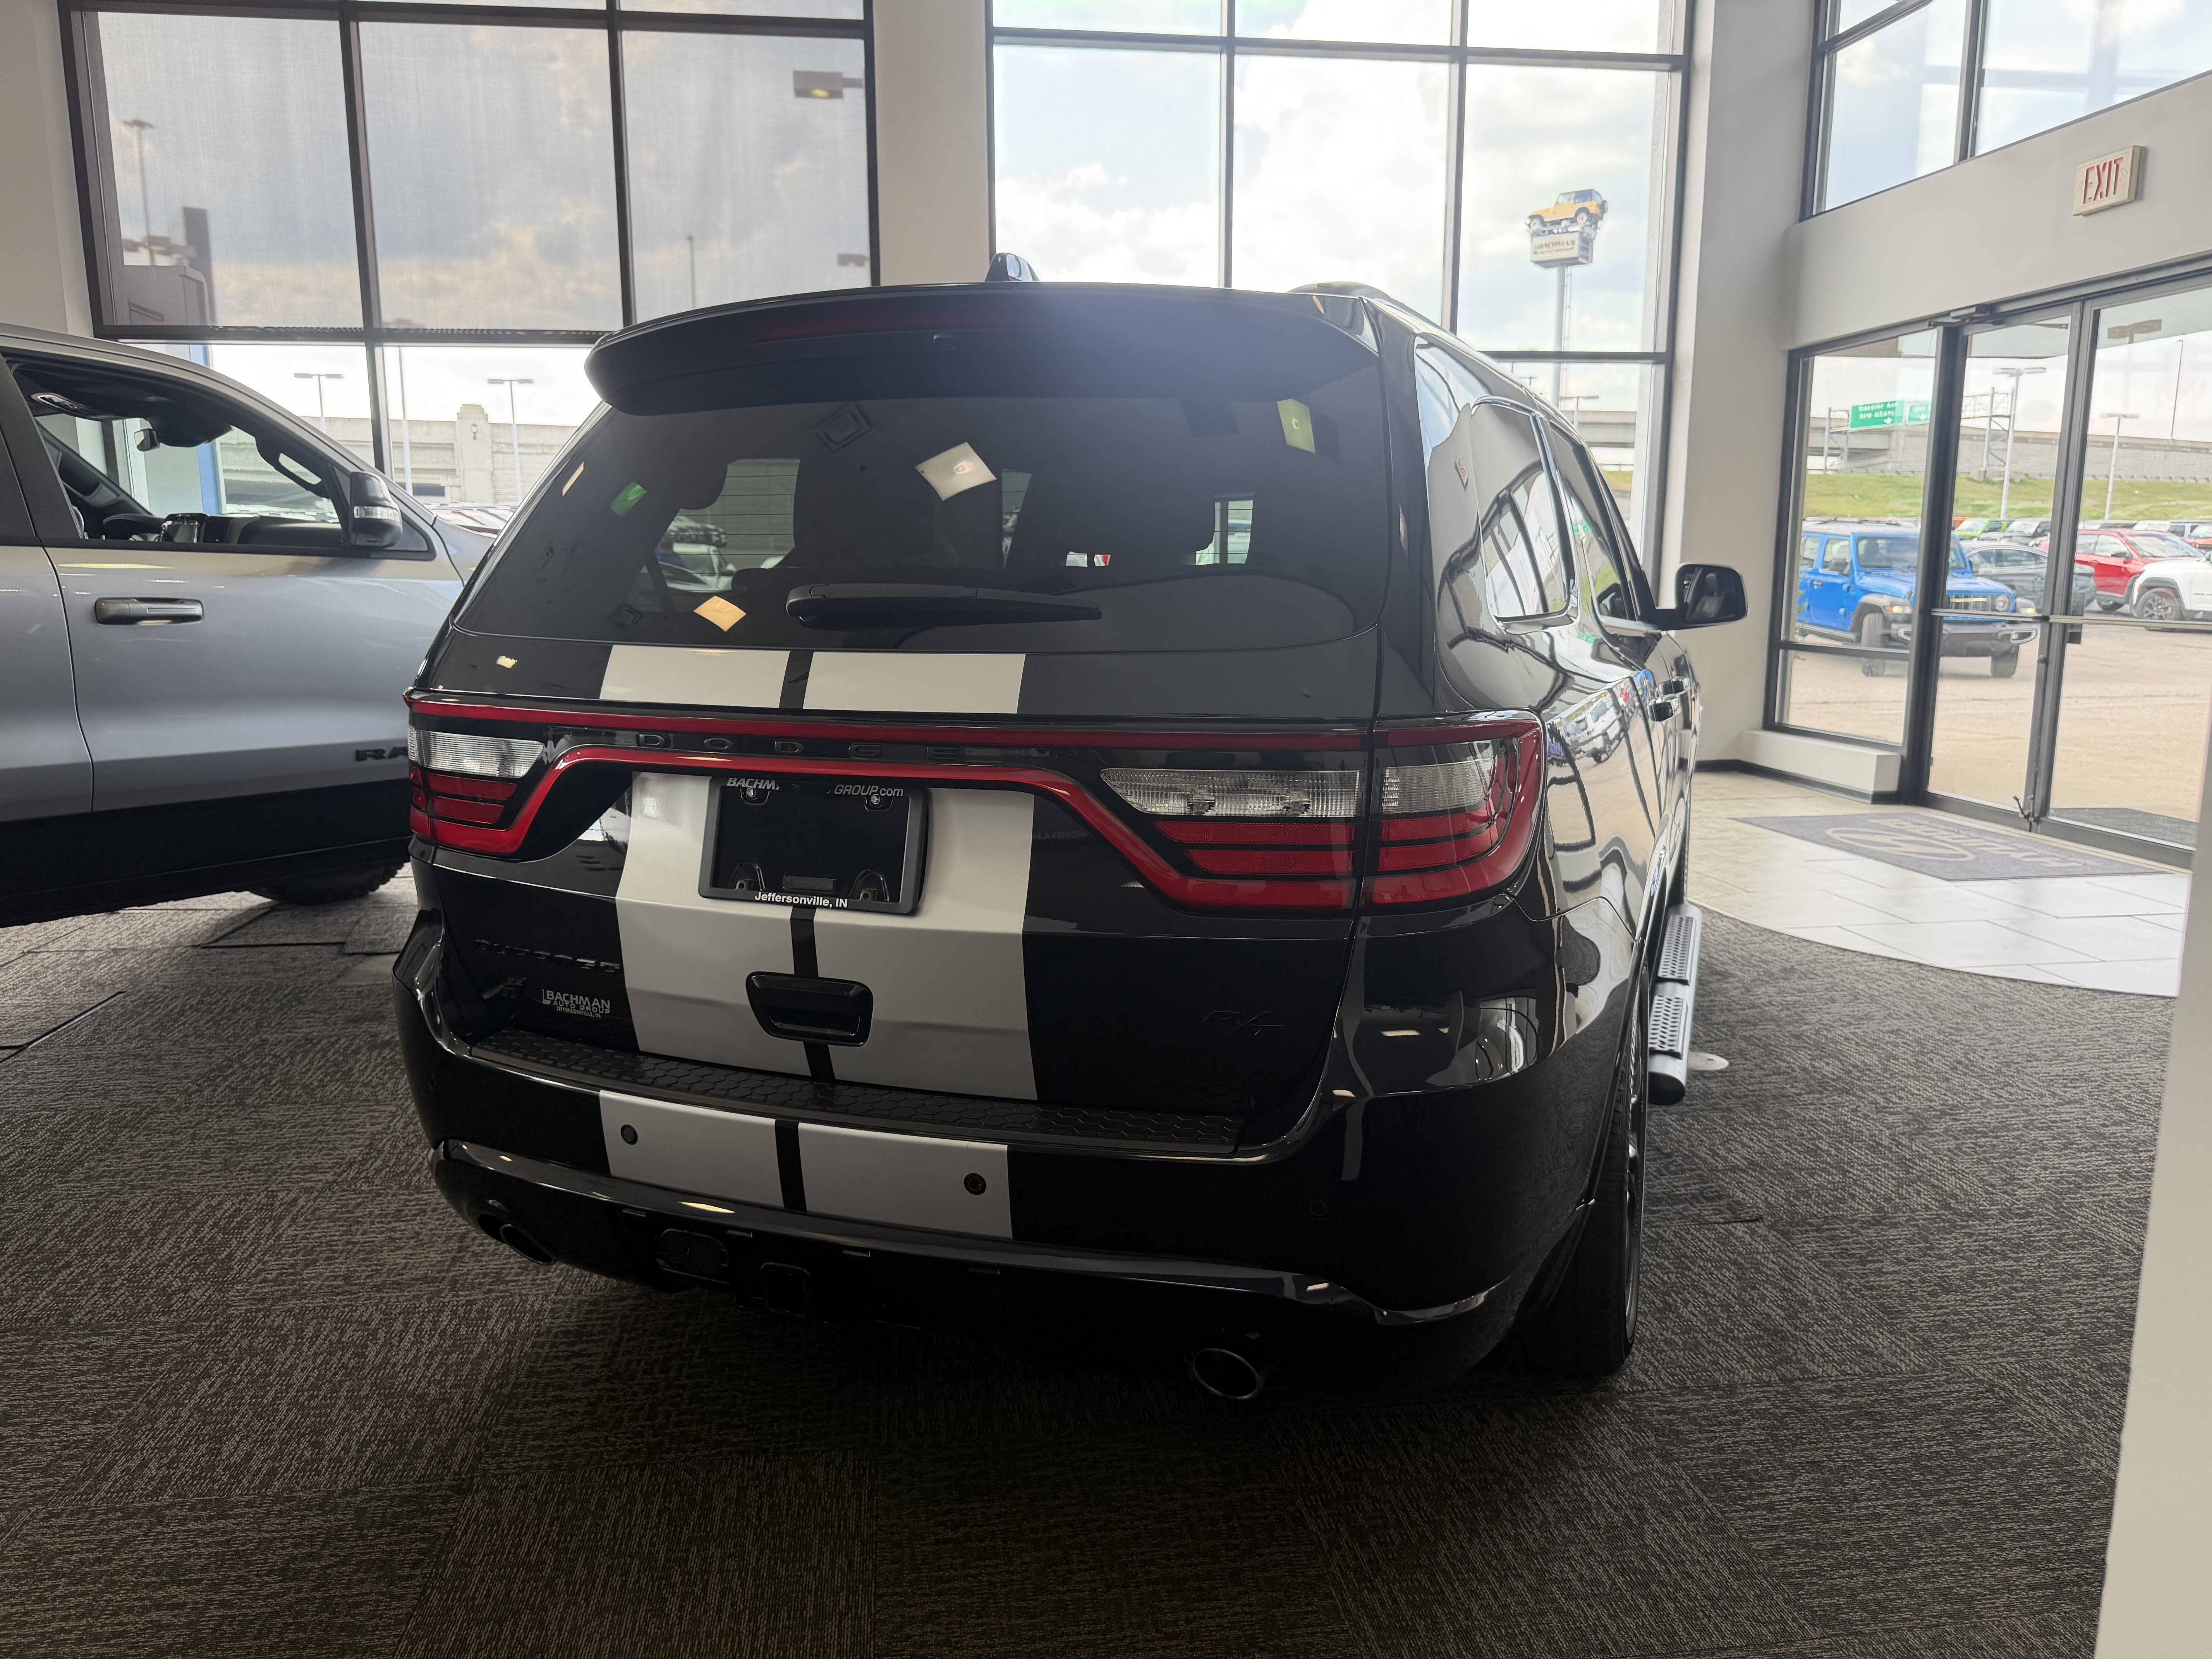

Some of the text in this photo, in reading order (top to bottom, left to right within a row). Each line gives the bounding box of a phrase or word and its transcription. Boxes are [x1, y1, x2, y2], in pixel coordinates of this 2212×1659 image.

[2083, 156, 2124, 204] EXIT
[356, 746, 408, 761] RA
[636, 733, 958, 760] DODGE
[726, 777, 780, 790] BACHM
[754, 891, 848, 908] Jeffersonville, IN
[546, 989, 611, 1009] BACHMAN
[553, 1000, 611, 1014] AUTO GROUP
